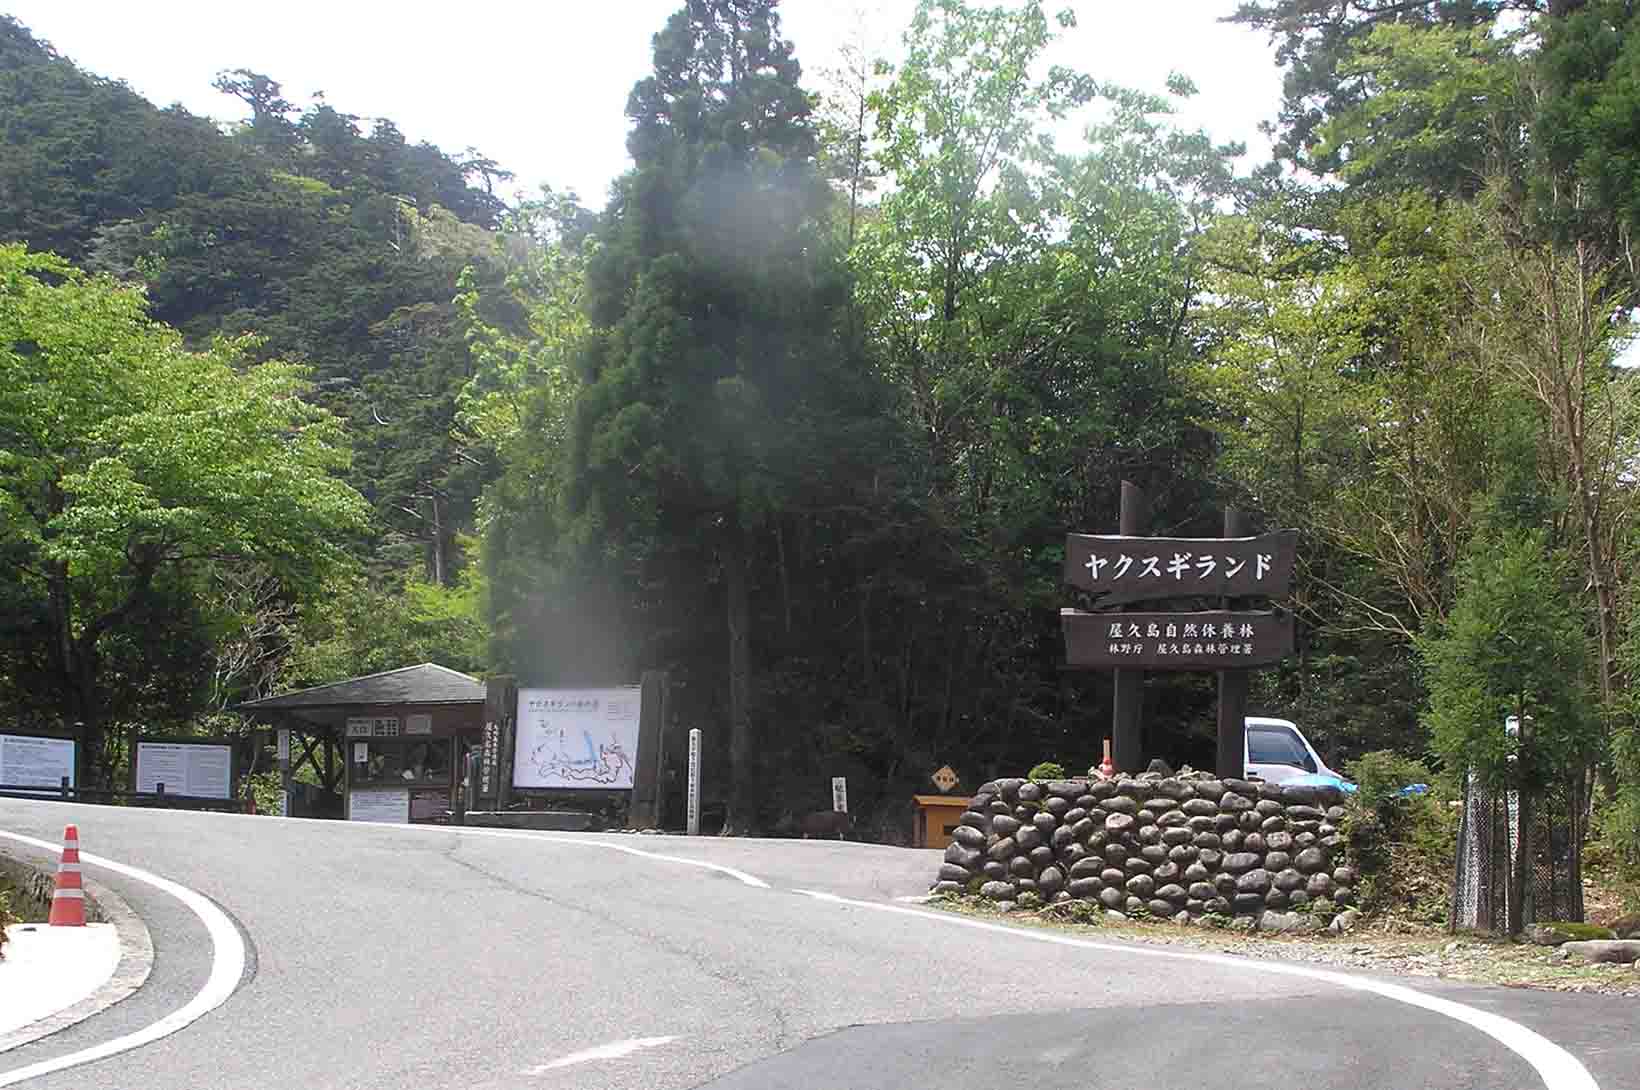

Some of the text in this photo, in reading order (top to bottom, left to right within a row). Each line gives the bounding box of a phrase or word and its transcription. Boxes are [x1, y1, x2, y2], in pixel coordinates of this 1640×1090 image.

[1085, 553, 1272, 580] ヤクスギランド
[1109, 622, 1255, 638] 屋久島自然休養林
[1109, 643, 1143, 655] 林野庁
